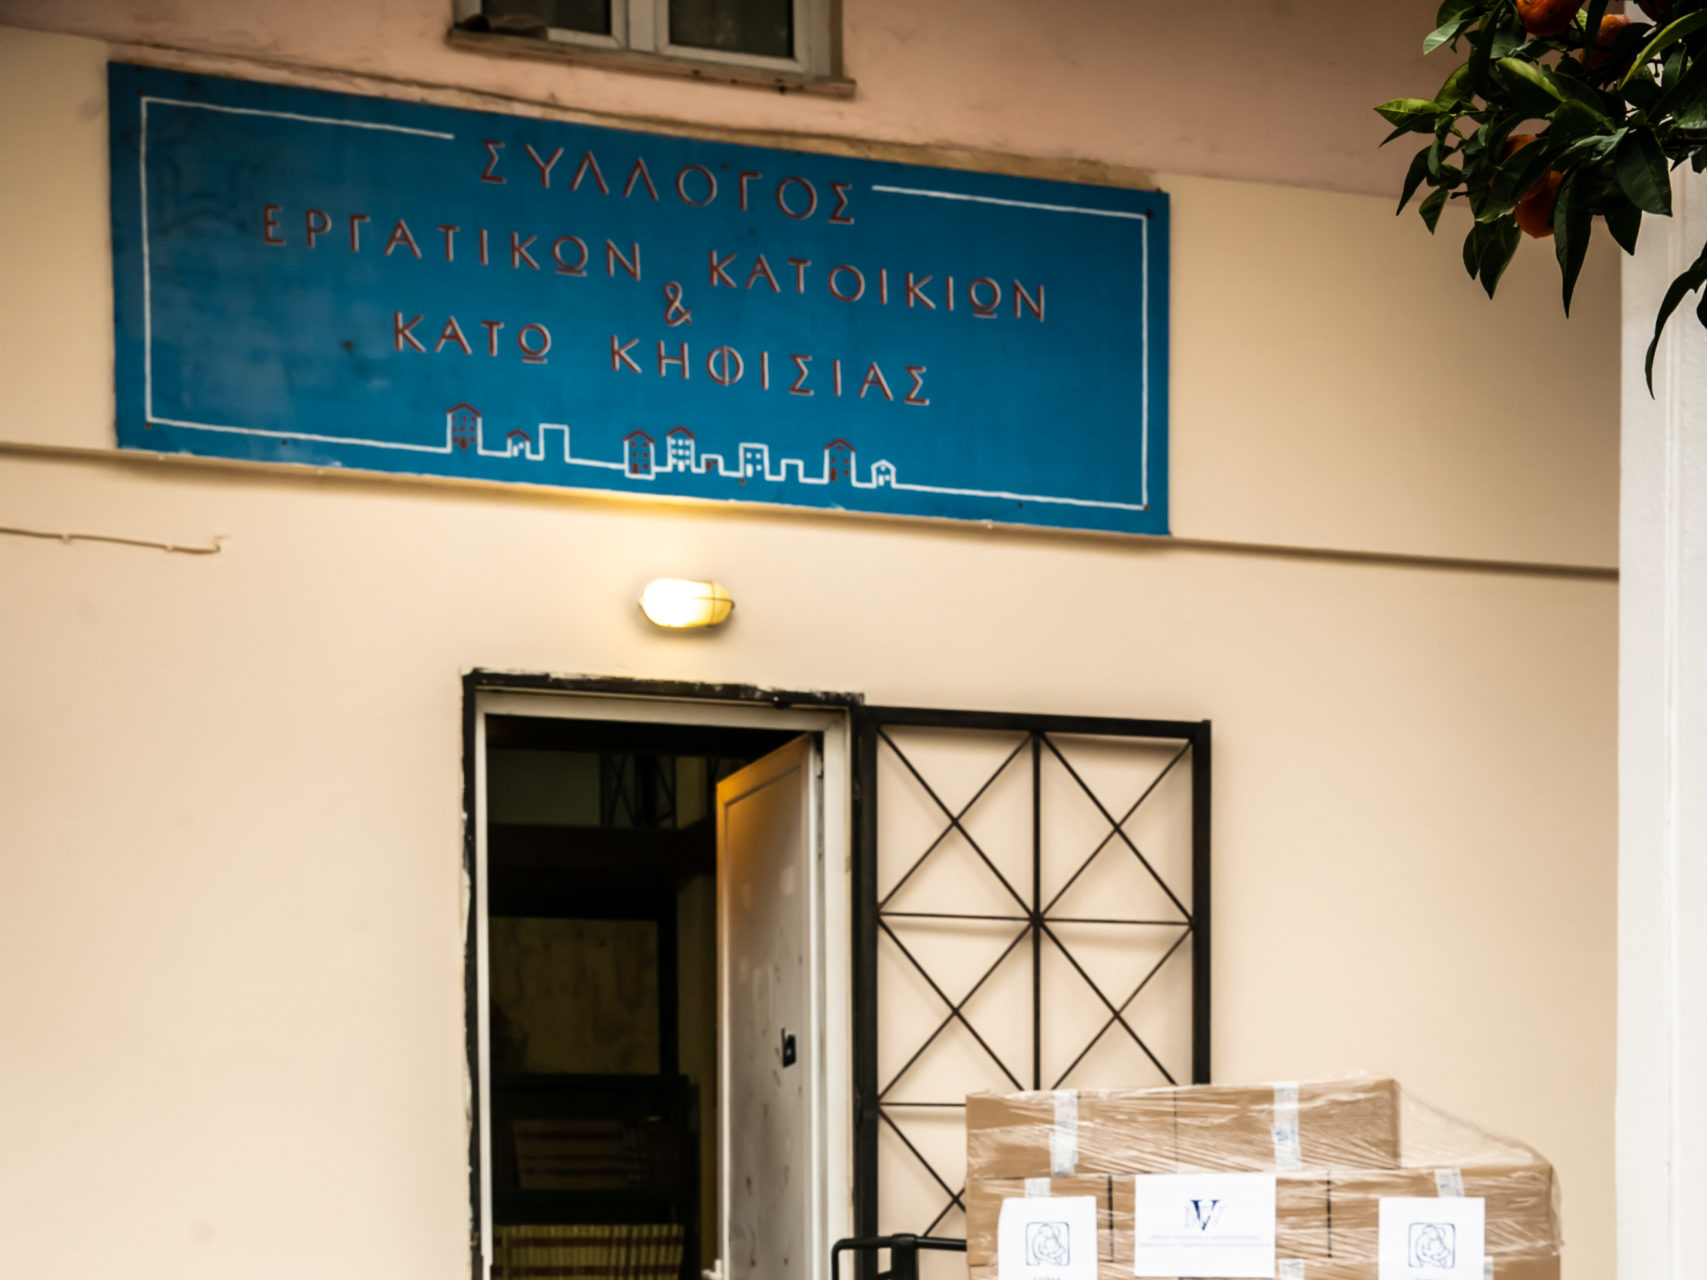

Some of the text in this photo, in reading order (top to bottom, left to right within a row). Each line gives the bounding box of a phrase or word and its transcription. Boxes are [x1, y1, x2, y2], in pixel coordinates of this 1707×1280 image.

[479, 139, 855, 224] ΣΥΛΛΟΓΟΣ
[263, 204, 1045, 322] ΕΡΓΑΤΙΚΩΝ ΚΑΤΟΙΚΙΩΝ
[663, 281, 693, 326] &
[393, 311, 930, 406] ΚΑΤΩ ΚΗΦΙΣΙΑΣ
